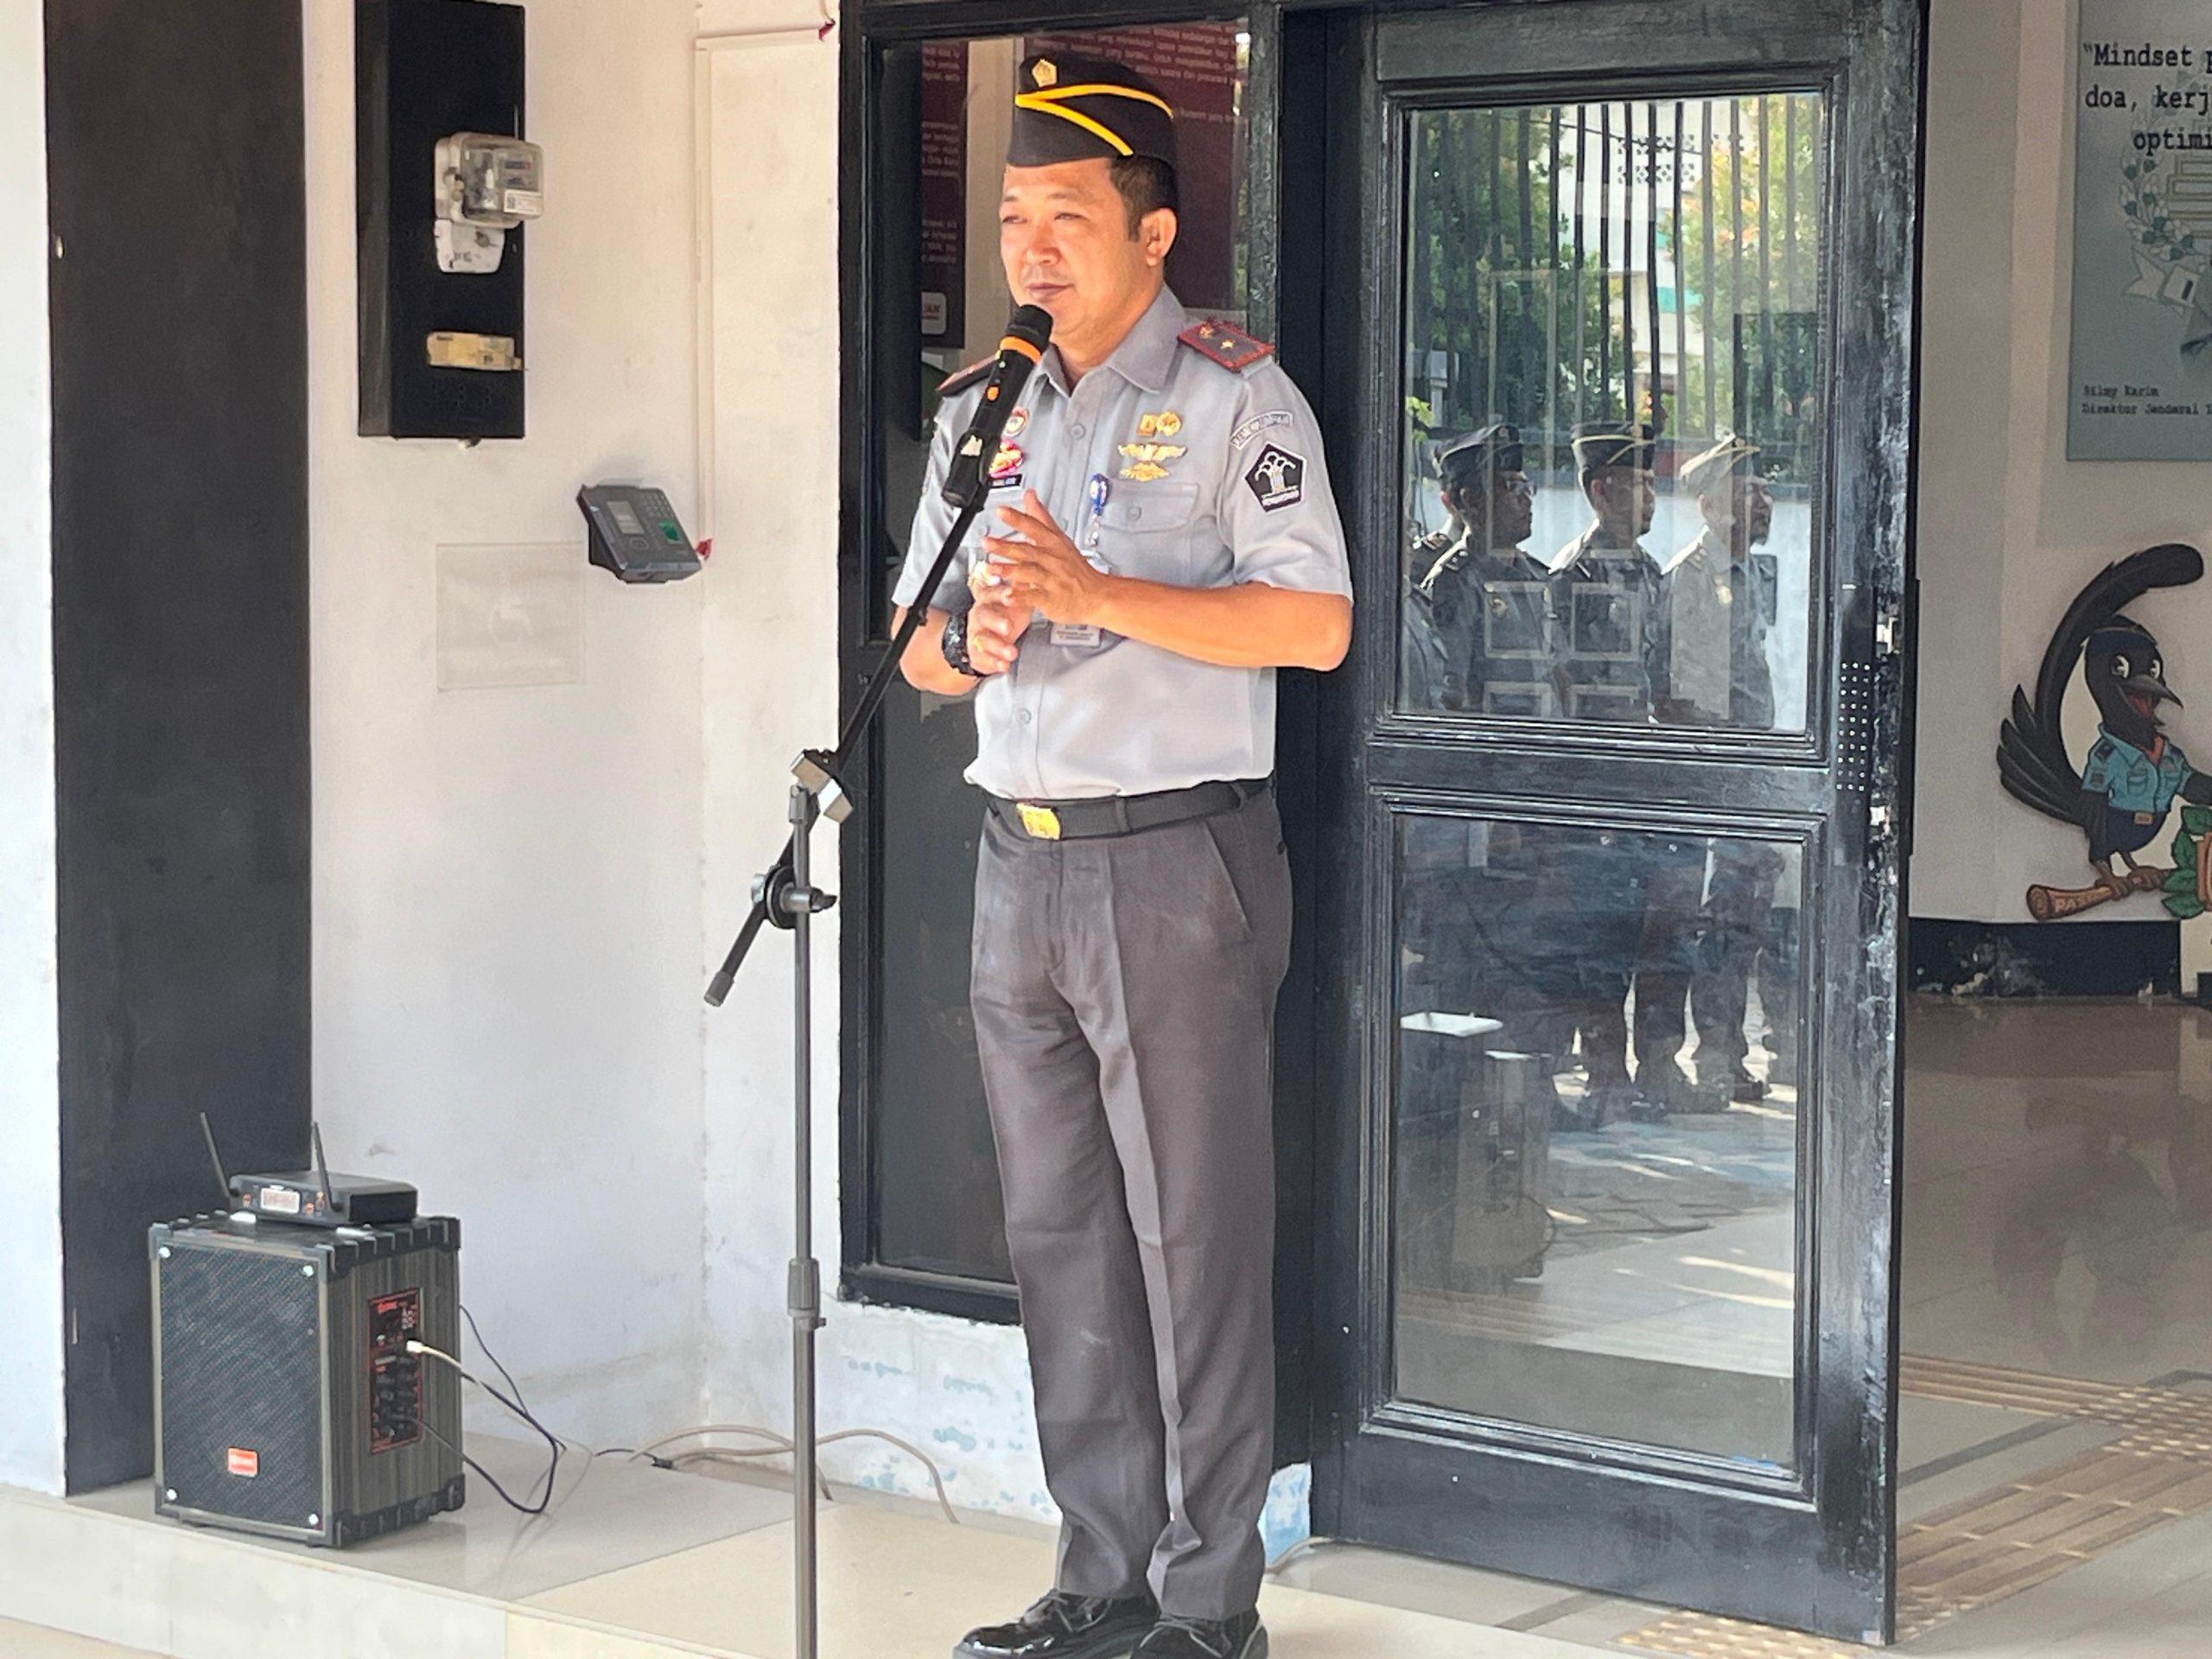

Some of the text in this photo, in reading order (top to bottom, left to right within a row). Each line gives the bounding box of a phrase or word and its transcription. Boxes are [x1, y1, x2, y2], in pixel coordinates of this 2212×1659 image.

[2083, 41, 2193, 67] "Mindset
[2085, 84, 2137, 112] doa,
[2081, 403, 2139, 415] Direktur
